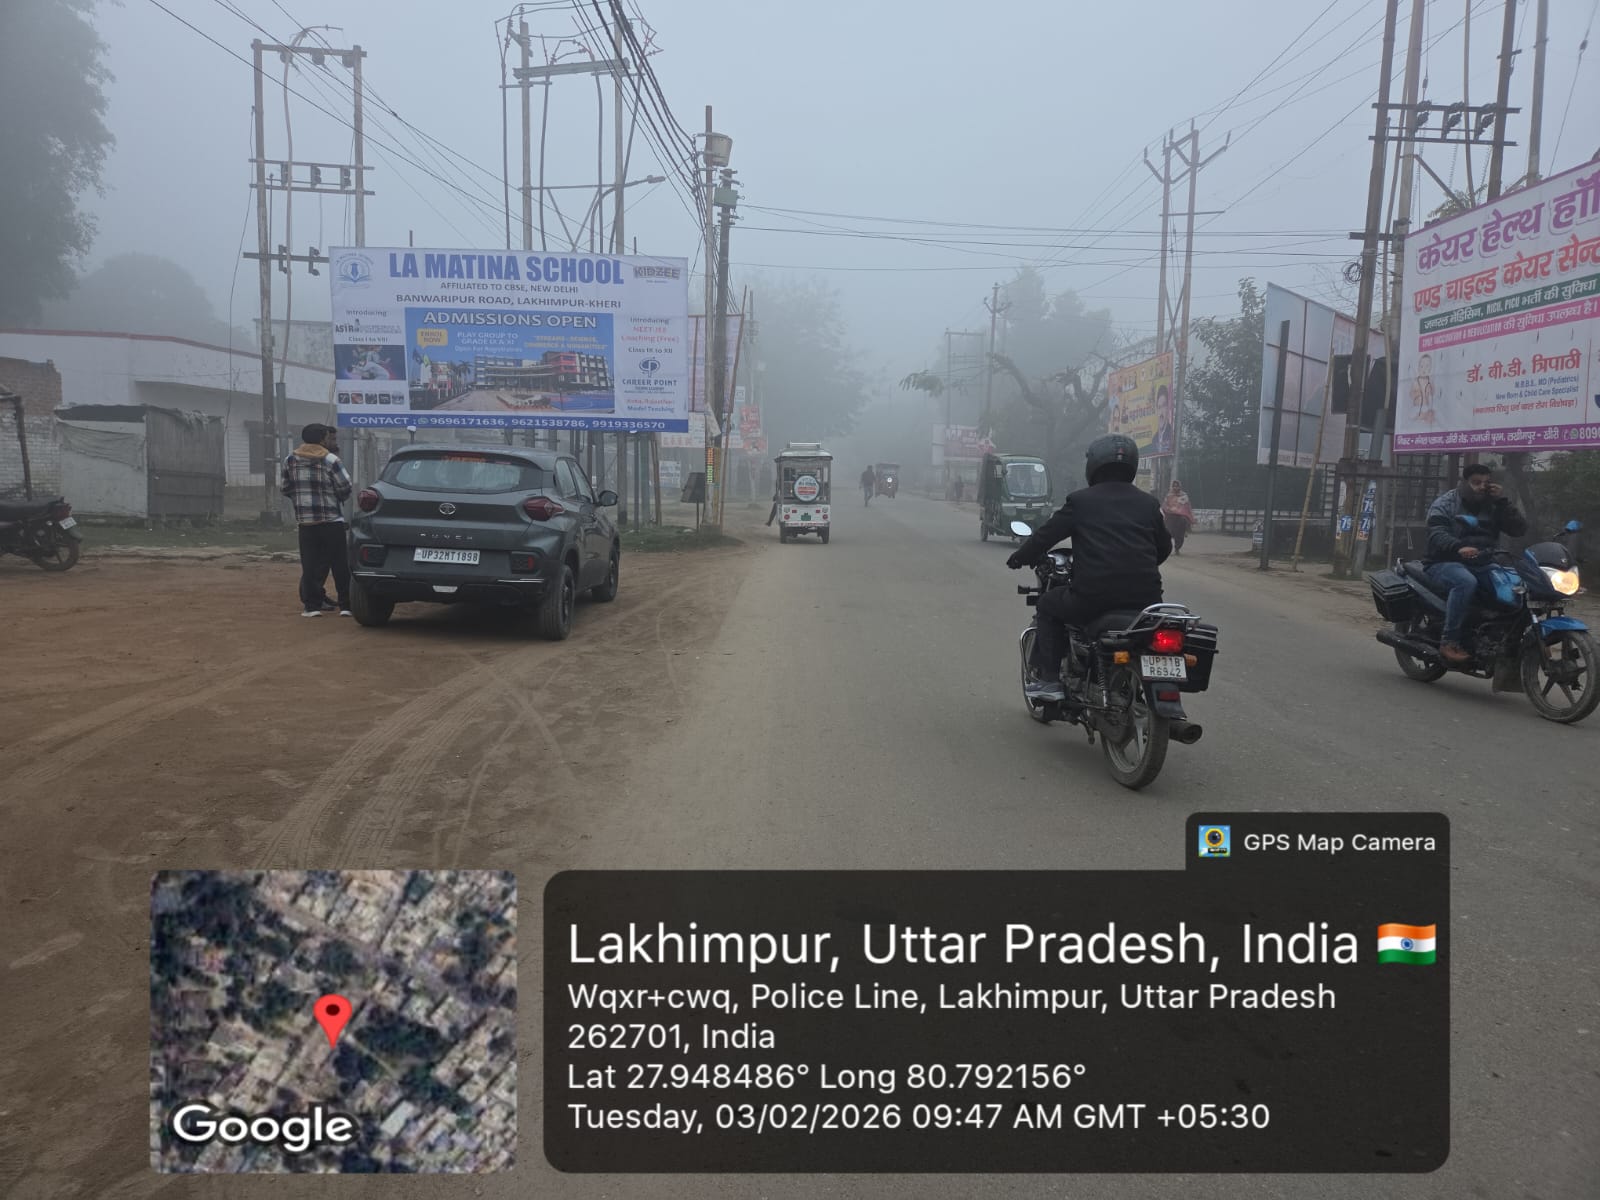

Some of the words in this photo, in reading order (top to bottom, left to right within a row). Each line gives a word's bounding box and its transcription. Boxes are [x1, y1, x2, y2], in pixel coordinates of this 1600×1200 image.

[1418, 233, 1478, 270] केयर
[1481, 208, 1546, 254] हेल्थ
[389, 253, 419, 278] LA
[424, 253, 521, 281] MATINA
[526, 256, 625, 285] SCHOOL
[633, 265, 681, 280] KIDZEE
[440, 282, 489, 291] AFFILIATED
[490, 283, 503, 291] TO
[504, 284, 529, 293] CBSE,
[530, 284, 551, 292] NEW
[553, 285, 579, 293] DELHI
[1414, 284, 1441, 312] एण्ड
[1446, 266, 1499, 301] चाइल्ड
[1503, 252, 1555, 286] केयर
[1521, 289, 1543, 305] भर्ती
[1543, 285, 1560, 300] की
[1561, 278, 1598, 300] सुविधा
[396, 294, 476, 304] BANWARIPUR
[478, 295, 515, 306] ROAD,
[517, 297, 622, 309] LAKHIMPUR-KHERI
[423, 311, 542, 327] ADMISSIONS
[546, 315, 597, 328] OPEN
[1503, 316, 1515, 330] की
[1516, 311, 1545, 330] सुविधा
[1546, 304, 1582, 321] उपलब्ध
[1466, 363, 1484, 384] डॉ.
[1532, 348, 1582, 374] त्रिपाठी
[653, 379, 677, 387] POINT
[350, 416, 409, 425] CONTACT
[592, 420, 666, 429] 9919336570
[421, 550, 479, 562] UP32MT1898
